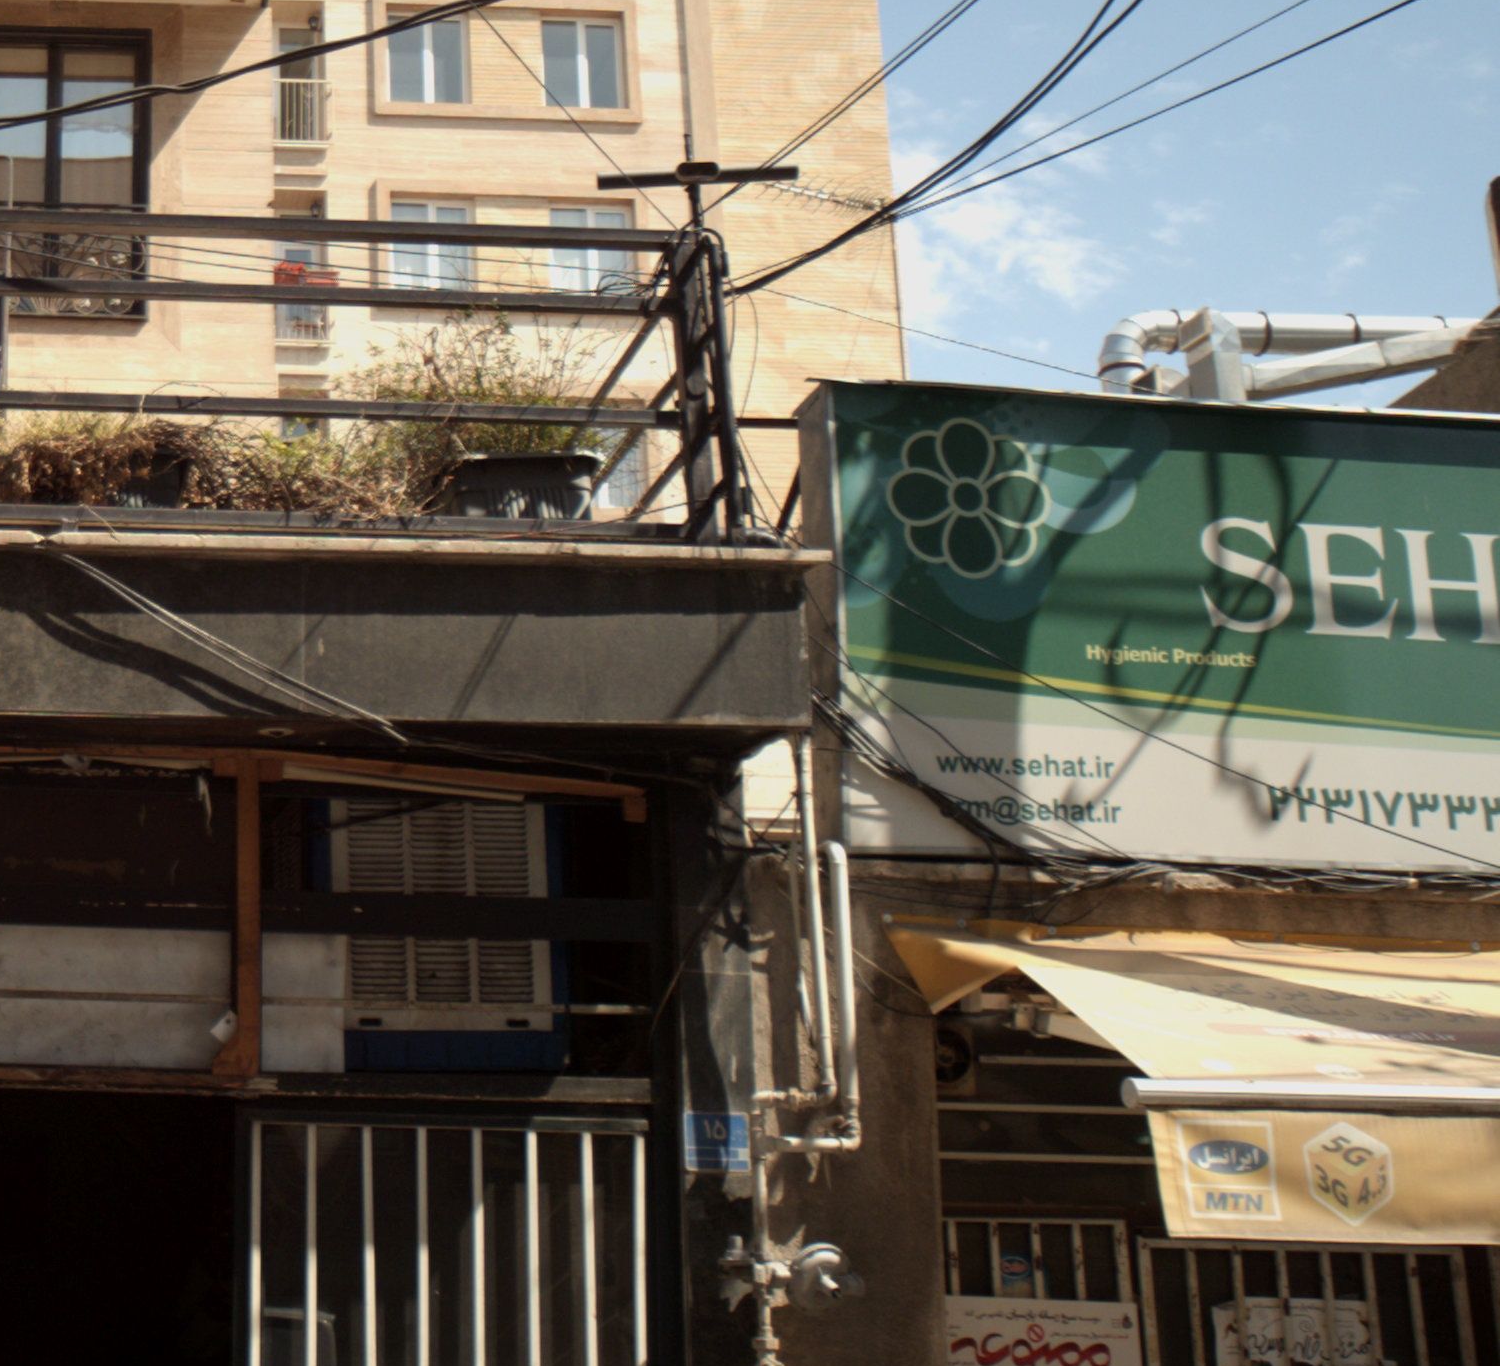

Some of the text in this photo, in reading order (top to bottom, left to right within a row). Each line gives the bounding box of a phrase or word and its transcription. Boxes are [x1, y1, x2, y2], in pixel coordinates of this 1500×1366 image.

[1200, 516, 1500, 646] SEH
[1085, 643, 1258, 668] Hygienic Products
[936, 754, 1115, 779] www.sehat.ir
[1197, 1145, 1261, 1172] ایرانسل
[1321, 1135, 1374, 1167] 5G
[1314, 1163, 1349, 1209] 3G
[1205, 1191, 1263, 1212] MTN
